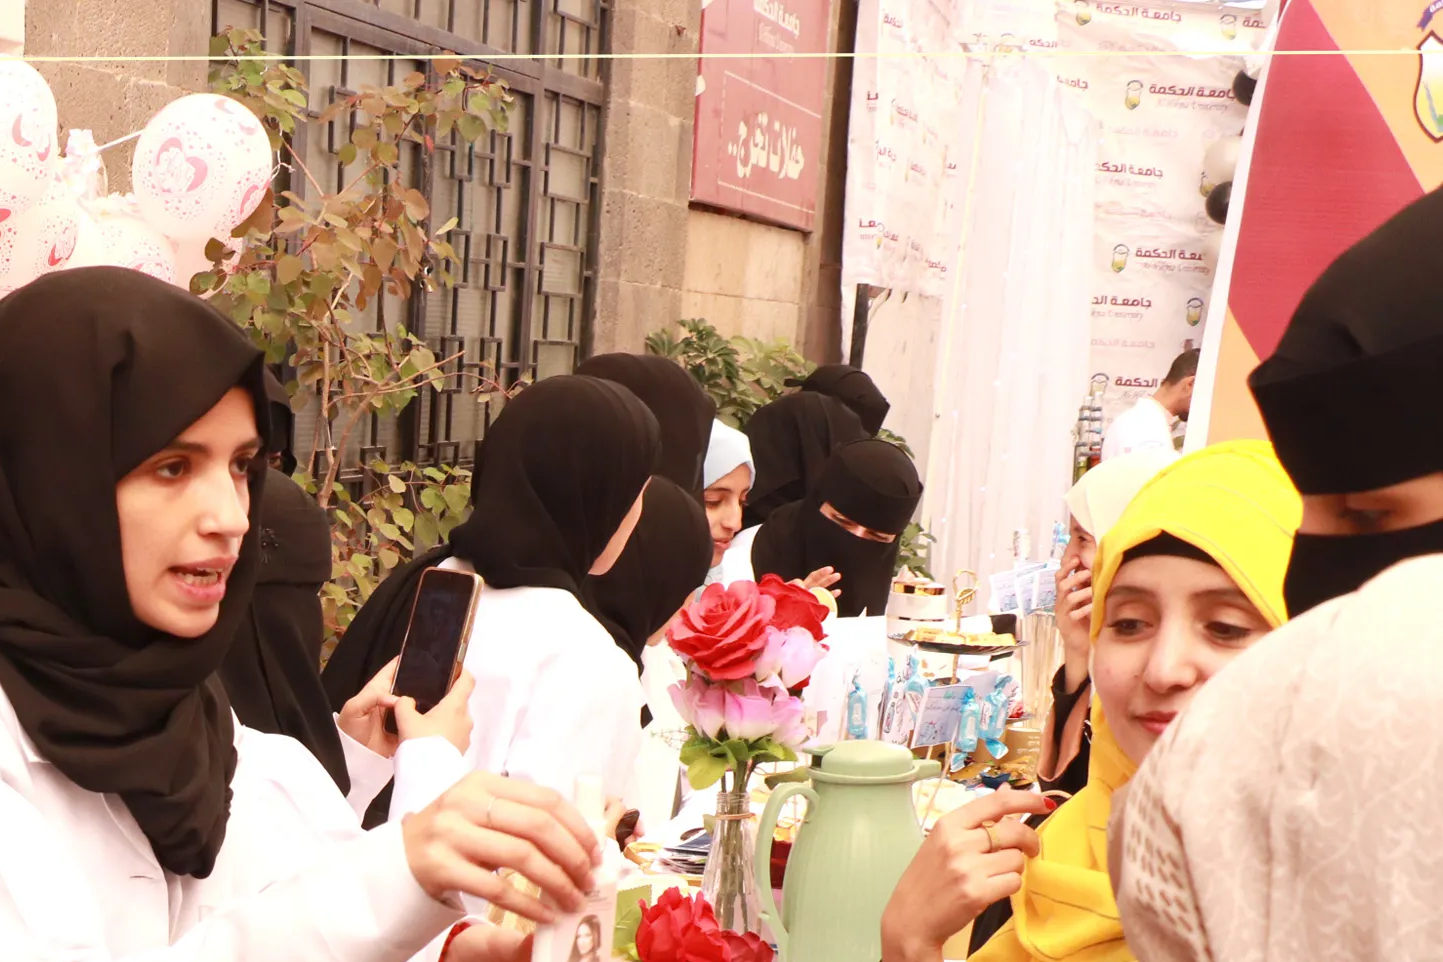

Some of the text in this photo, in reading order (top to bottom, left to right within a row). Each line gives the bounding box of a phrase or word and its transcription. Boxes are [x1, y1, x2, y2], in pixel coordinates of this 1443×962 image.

[1096, 2, 1182, 24] جامعة الحكمة
[1149, 83, 1196, 97] الحكمة
[769, 120, 805, 180] حفلات
[1129, 163, 1164, 180] جامعة
[1136, 247, 1177, 260] الحكمة
[1110, 295, 1153, 310] جامعة
[1116, 376, 1158, 389] الحكمة
